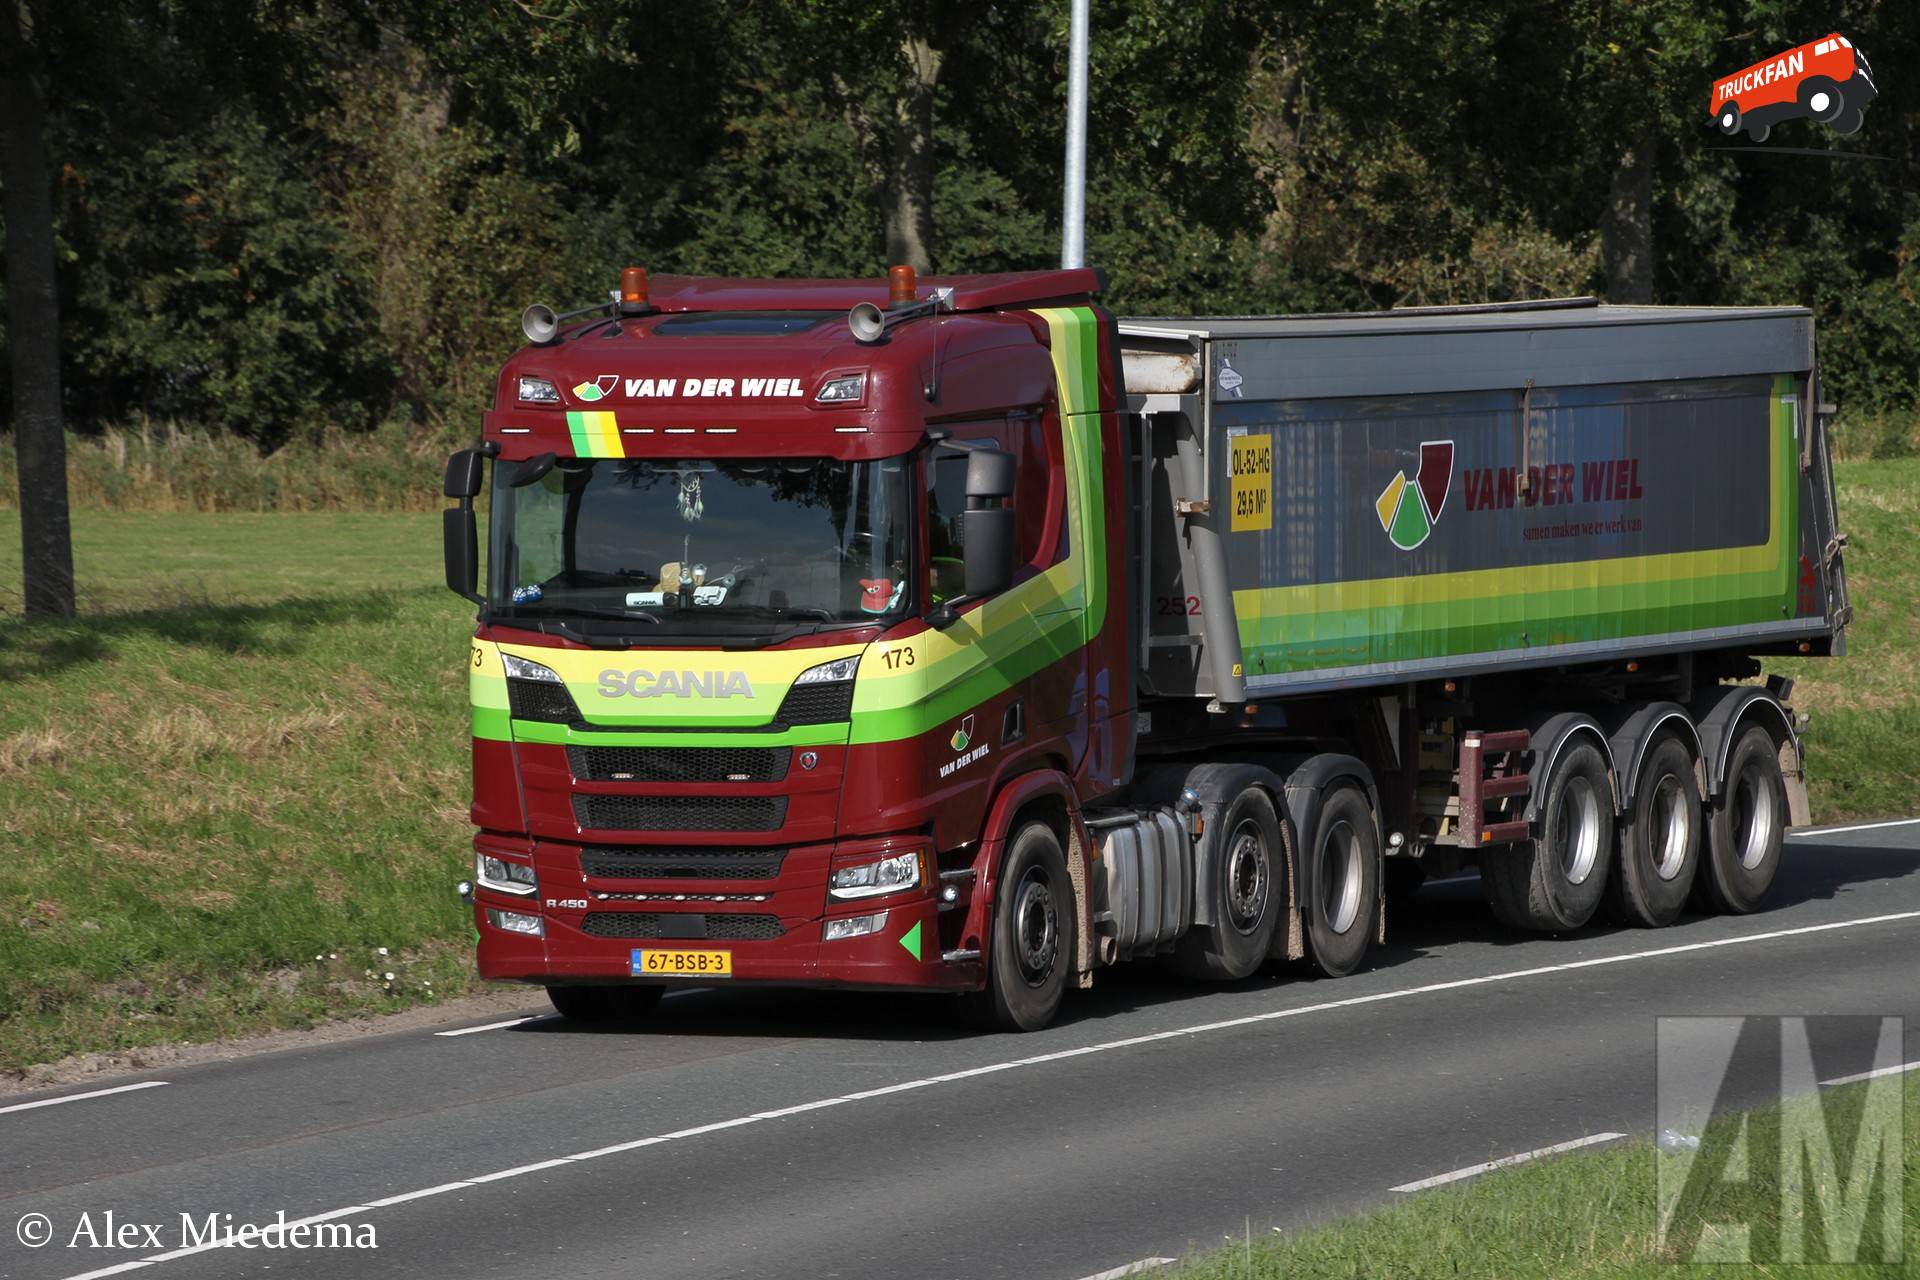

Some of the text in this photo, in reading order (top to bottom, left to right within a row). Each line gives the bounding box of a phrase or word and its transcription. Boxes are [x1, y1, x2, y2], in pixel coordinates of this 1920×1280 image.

[624, 378, 804, 397] VAN DER WIEL
[1232, 447, 1271, 476] OL-52-HG
[1463, 458, 1643, 512] VAN DER WIEL
[1236, 489, 1254, 519] 29,6
[1522, 527, 1550, 541] samen
[1551, 519, 1580, 538] maken
[1604, 514, 1626, 534] werk
[1627, 518, 1643, 533] van
[1157, 595, 1202, 616] 252
[881, 646, 915, 669] 173
[597, 669, 754, 699] SCANIA
[939, 743, 990, 778] VAN DER WIEL
[546, 899, 588, 909] R 450
[648, 954, 724, 970] 67-BSB-3
